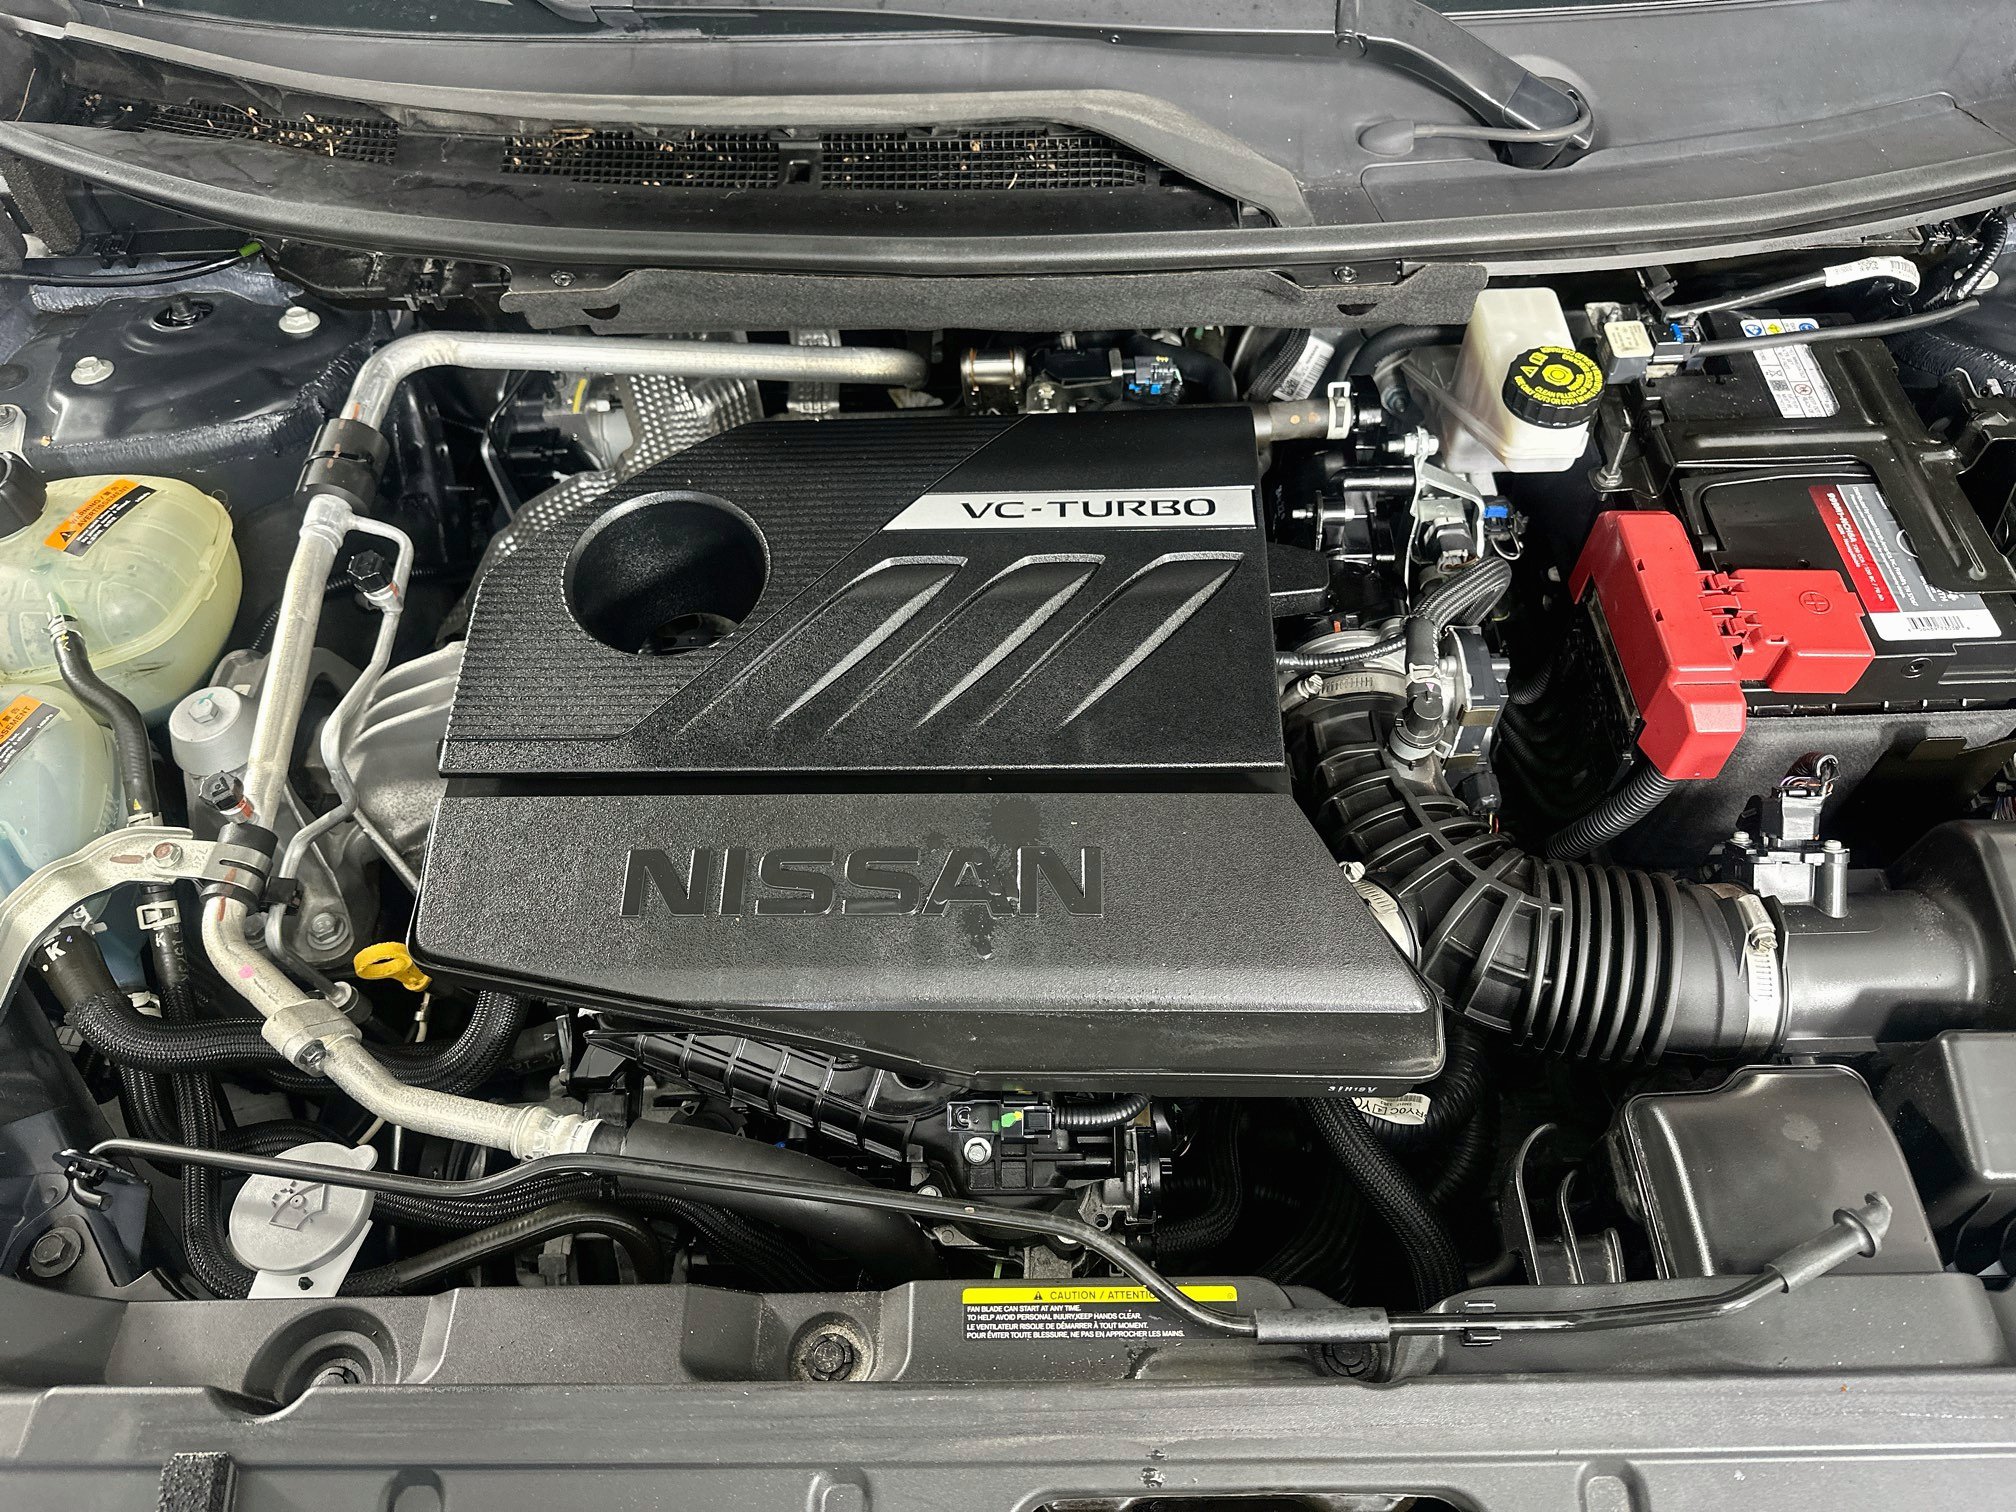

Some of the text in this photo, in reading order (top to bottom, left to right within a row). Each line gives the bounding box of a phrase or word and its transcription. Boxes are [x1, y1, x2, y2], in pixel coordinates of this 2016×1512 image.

[961, 498, 1217, 519] VC-TURBO
[620, 846, 1104, 918] NISSAN
[1050, 1290, 1096, 1300] CAUTION
[1100, 1291, 1104, 1300] /
[1056, 1321, 1092, 1329] DÉMARRER
[987, 1330, 1010, 1338] ÉVITER
